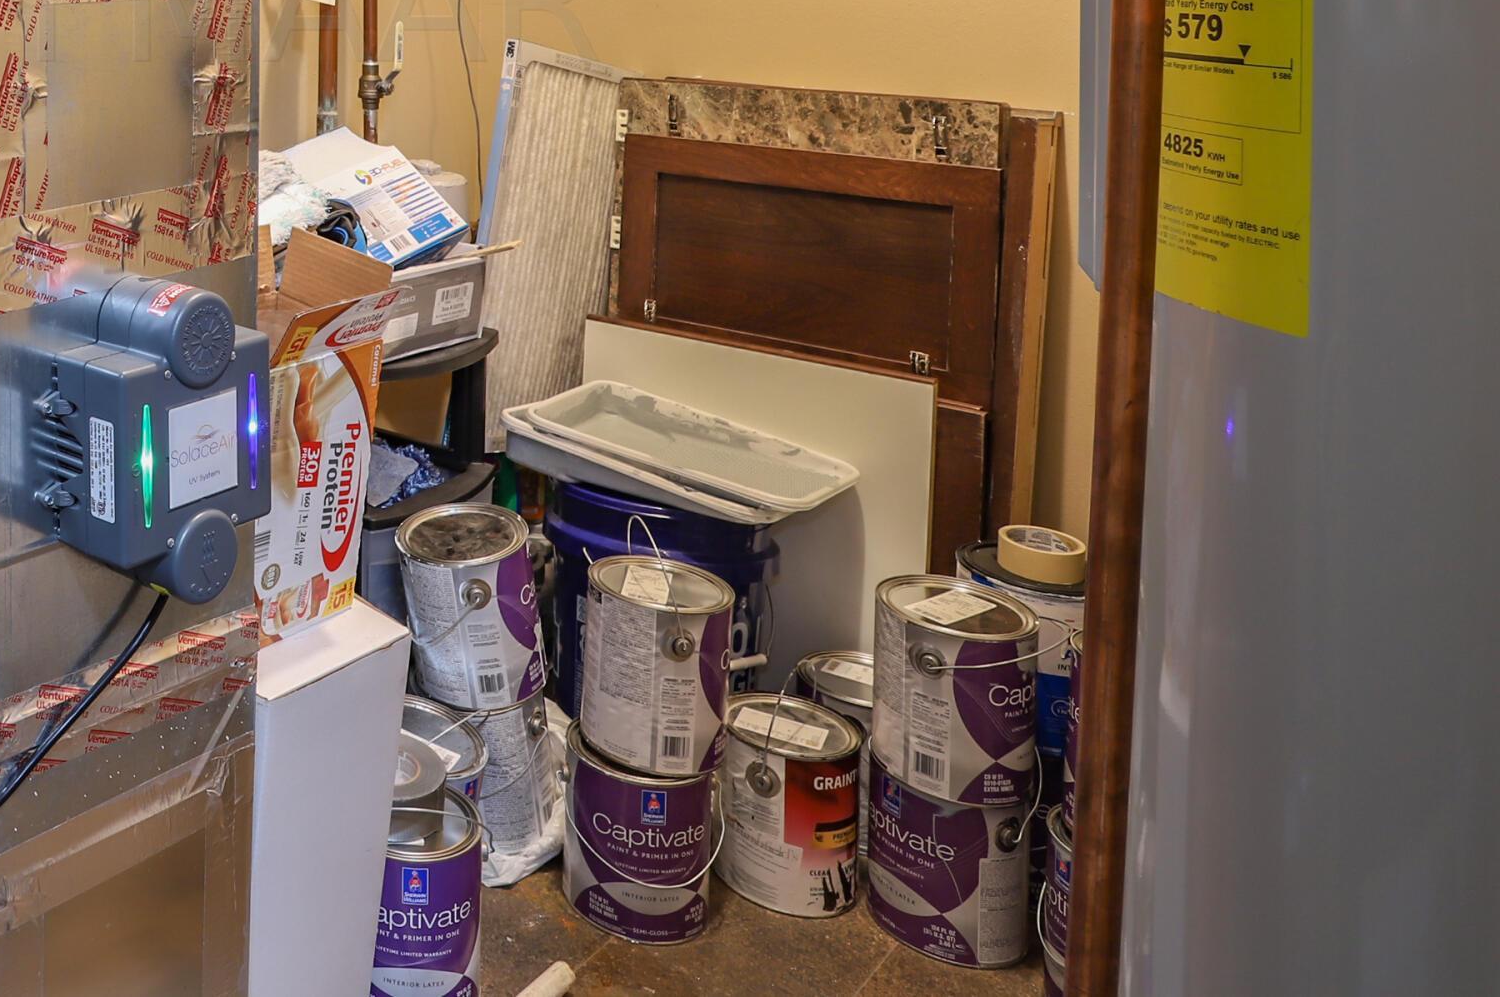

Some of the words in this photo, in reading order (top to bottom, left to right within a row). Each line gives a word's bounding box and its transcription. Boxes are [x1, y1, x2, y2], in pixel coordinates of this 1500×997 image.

[4, 0, 20, 33] 1581A
[1199, 0, 1229, 12] Energy
[1230, 0, 1255, 12] Cost
[1177, 13, 1224, 42] 579
[506, 41, 516, 59] 3M
[1213, 65, 1235, 75] Models
[1163, 132, 1205, 158] 4825
[1207, 151, 1226, 163] KWH
[1185, 162, 1202, 174] Yearly
[1202, 165, 1225, 179] Energy
[1226, 170, 1240, 181] Use
[91, 222, 140, 247] VentureTape
[1185, 208, 1194, 217] on
[1194, 210, 1211, 222] your
[1212, 212, 1234, 228] utility
[1235, 219, 1258, 233] rates
[1259, 224, 1279, 237] and
[1281, 229, 1301, 242] use
[11, 253, 35, 270] 1581A
[14, 241, 68, 265] VentureTape
[146, 250, 165, 263] COLD
[165, 255, 195, 271] WEATHER
[3, 282, 25, 296] COLD
[369, 343, 381, 388] Caramel
[170, 433, 236, 469] SolaceAir
[298, 447, 308, 483] PROTEIN
[304, 447, 321, 483] 30g
[320, 441, 343, 531] Protein
[334, 419, 362, 535] Premier
[303, 491, 312, 509] 160
[299, 531, 307, 543] 24
[331, 582, 348, 611] 15
[813, 770, 857, 791] GRAINT
[592, 812, 705, 849] Captivate
[869, 801, 956, 862] aptivate
[606, 842, 629, 855] PAINT
[641, 851, 669, 860] PRIMER
[681, 849, 694, 858] ONE
[905, 850, 916, 860] IN
[917, 857, 936, 871] ONE
[621, 890, 658, 903] INTERIOR
[659, 895, 680, 903] LATEX
[377, 897, 473, 931] aptivate
[402, 931, 433, 943] PRIMER
[434, 933, 444, 941] IN
[445, 928, 461, 939] ONE
[632, 927, 669, 937] SEMI-GLOSS
[383, 976, 421, 988] INTERIOR
[422, 980, 445, 989] LATEX
